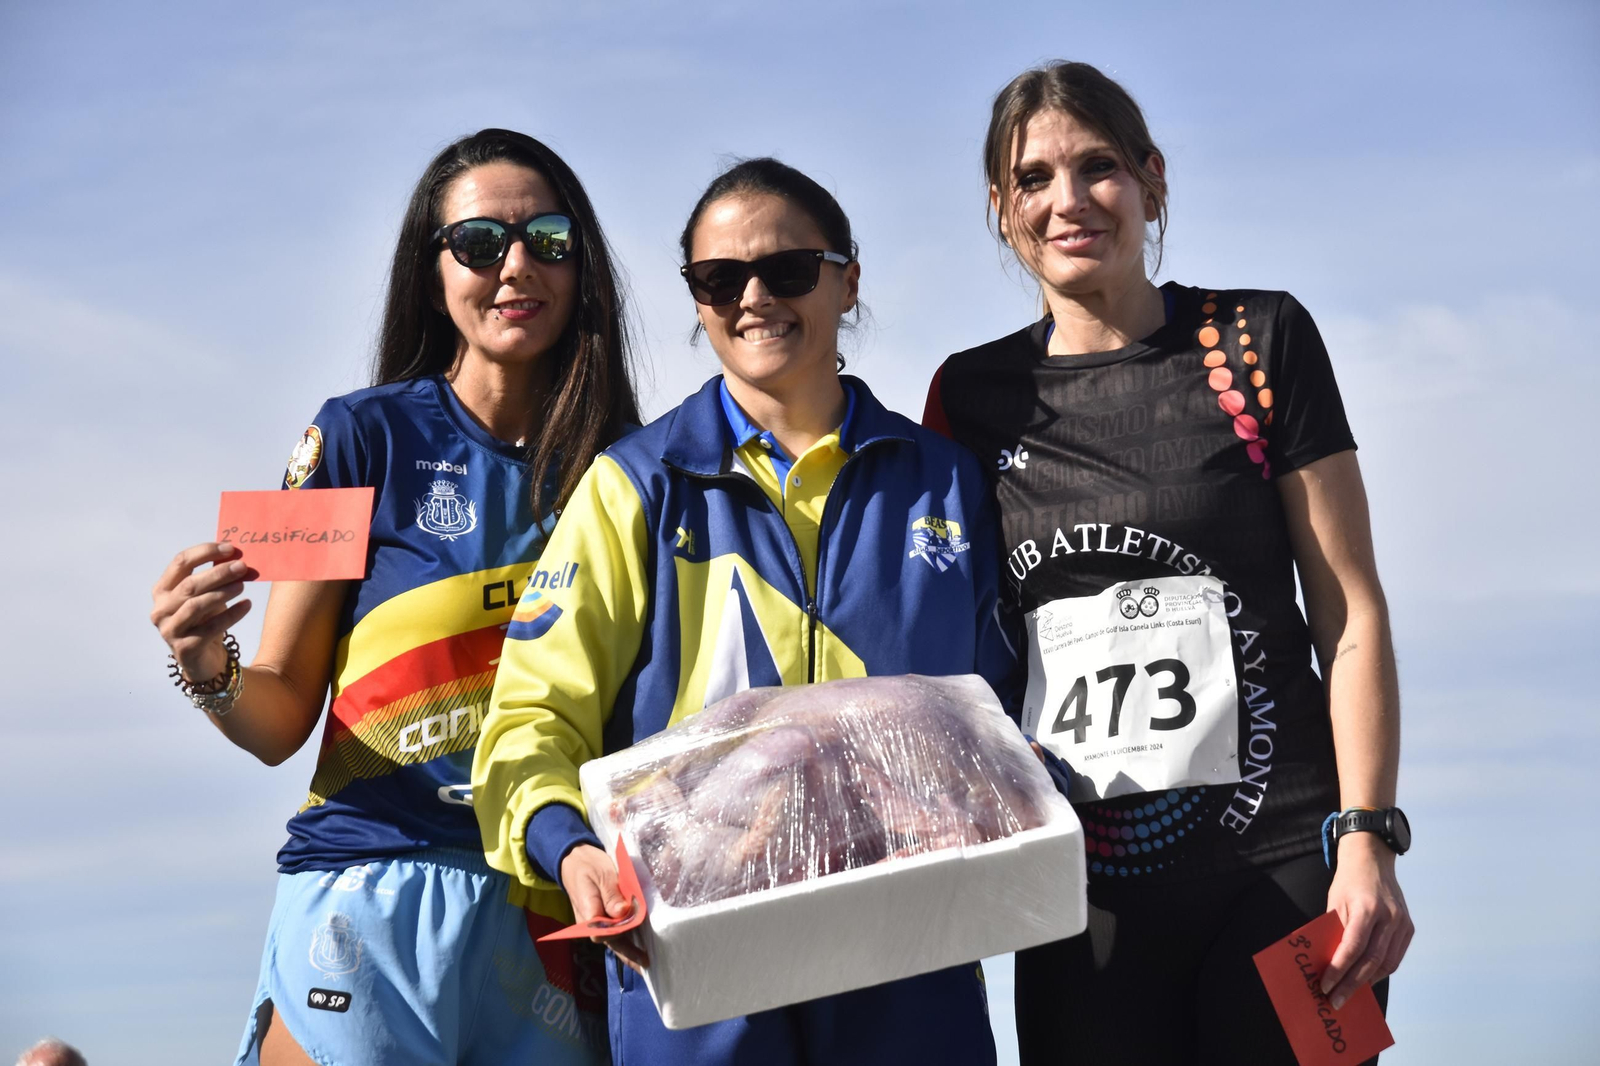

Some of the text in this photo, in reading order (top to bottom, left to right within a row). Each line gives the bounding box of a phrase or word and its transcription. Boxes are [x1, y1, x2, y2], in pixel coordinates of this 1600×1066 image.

[415, 459, 468, 476] mobel
[924, 516, 948, 529] BEAS
[1106, 625, 1118, 634] Golf
[1118, 624, 1129, 633] Isla
[1130, 623, 1149, 632] Canela
[1150, 621, 1165, 629] Links
[1166, 618, 1184, 628] (Costa
[1051, 658, 1197, 744] 473
[1219, 628, 1277, 835] AYAMONTE
[1084, 750, 1110, 762] AYAMONTE
[1117, 745, 1148, 755] DICIEMBRE
[1149, 743, 1163, 751] 2024
[328, 995, 346, 1008] SP
